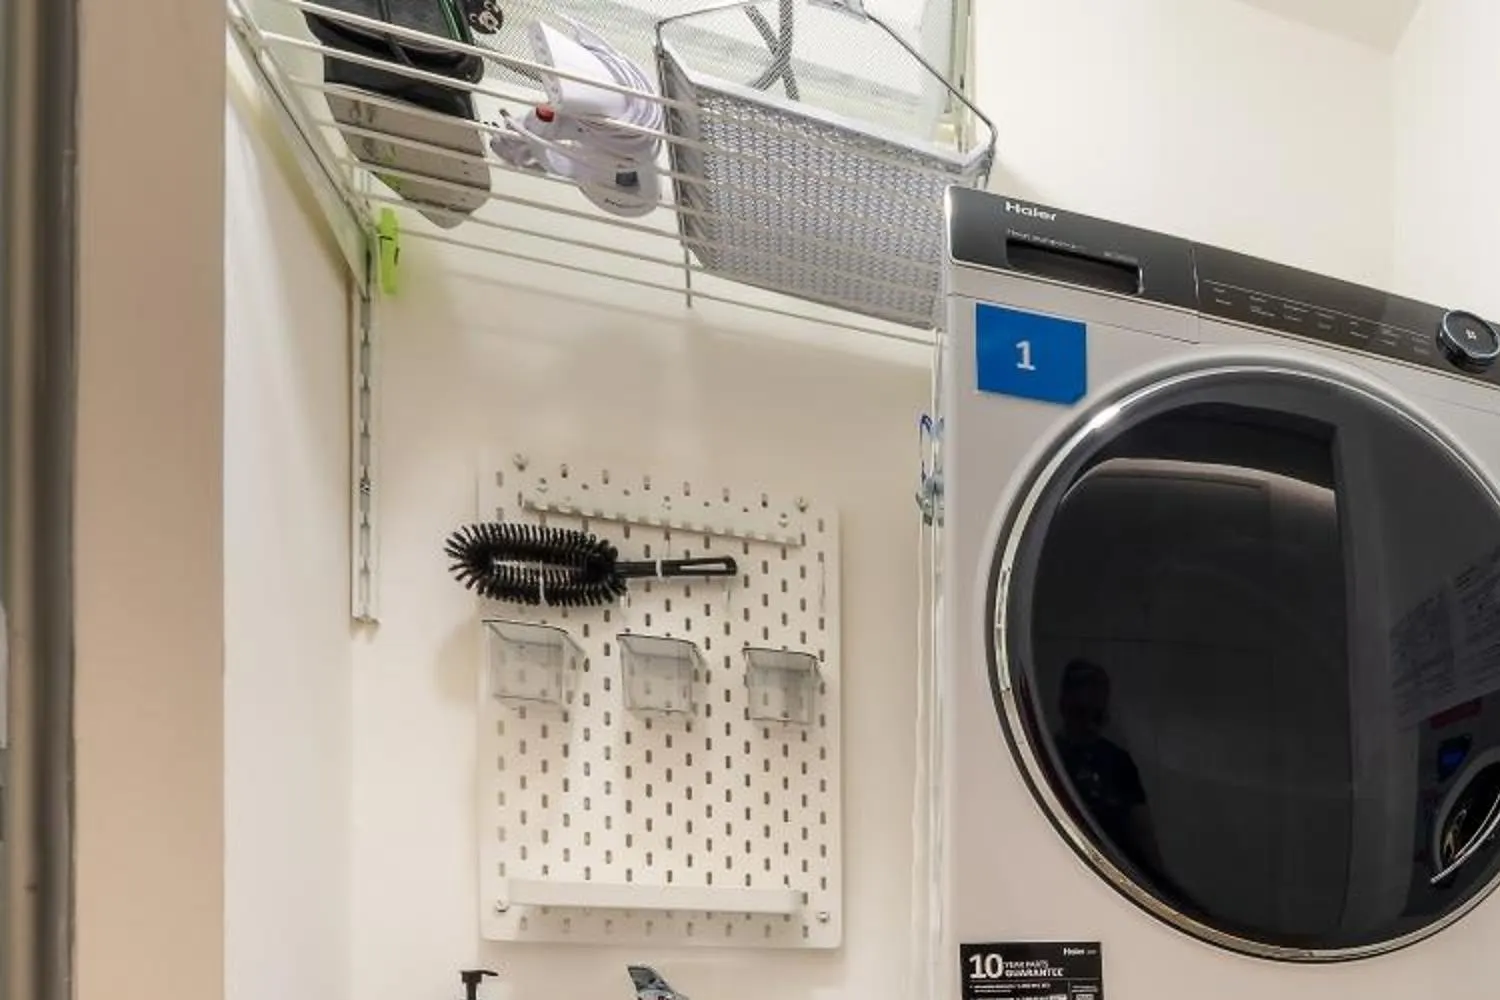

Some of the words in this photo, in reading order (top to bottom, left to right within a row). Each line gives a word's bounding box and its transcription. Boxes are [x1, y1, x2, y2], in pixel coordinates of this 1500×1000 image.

[1005, 201, 1056, 221] Haier
[1016, 341, 1036, 371] 1
[969, 953, 1003, 978] 10
[1005, 968, 1063, 977] GUARANTEE
